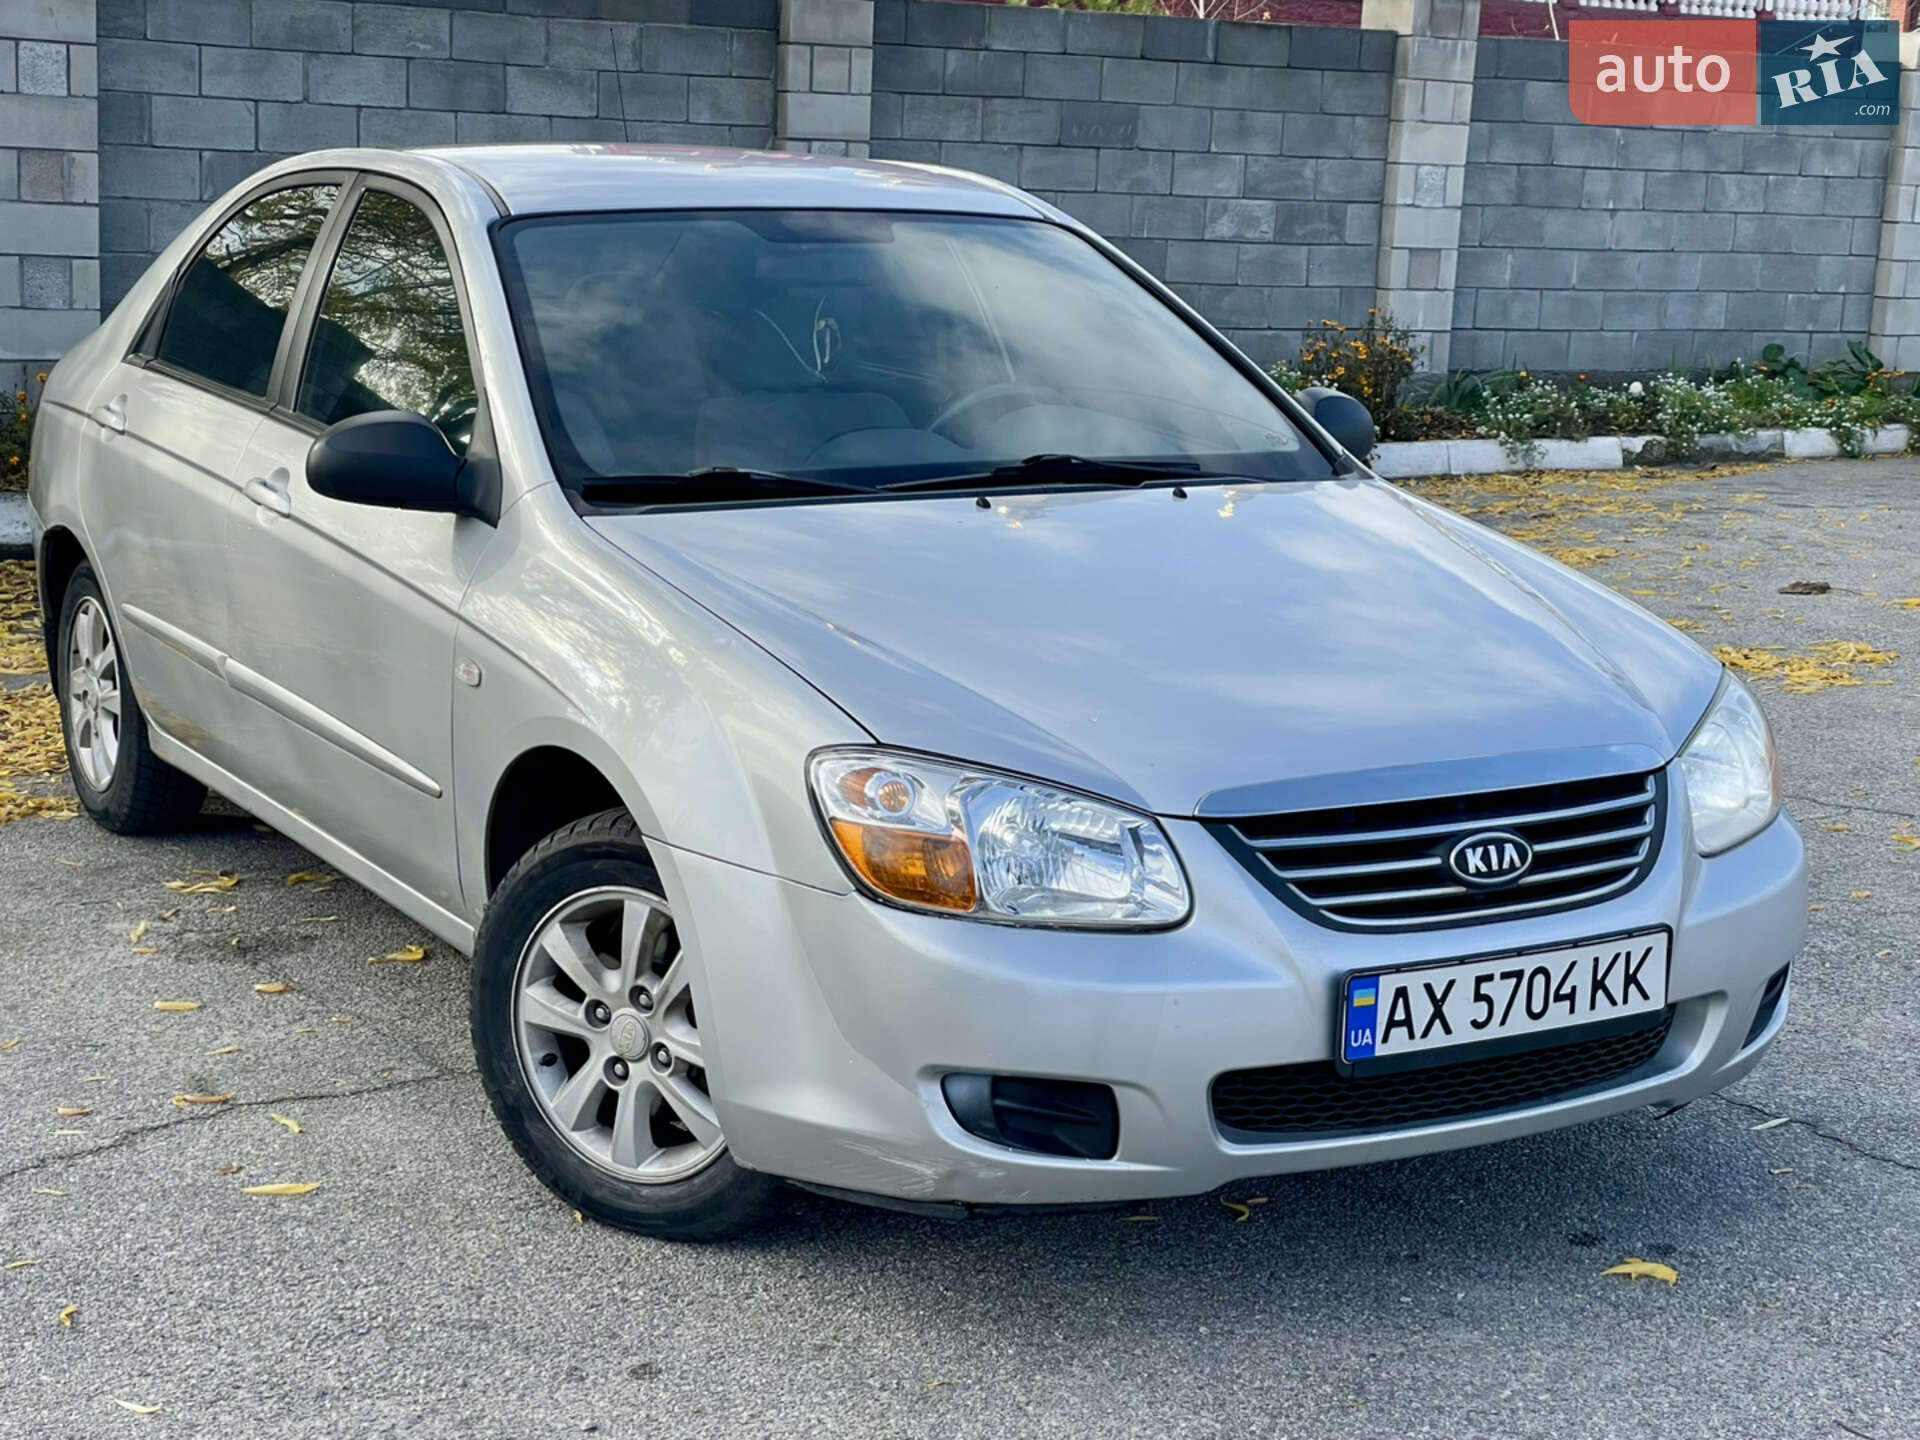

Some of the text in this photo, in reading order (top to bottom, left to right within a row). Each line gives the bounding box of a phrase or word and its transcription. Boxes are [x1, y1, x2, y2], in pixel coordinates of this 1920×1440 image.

[1464, 843, 1522, 874] KIA
[1381, 946, 1654, 1044] AX 5704 KK
[1351, 1027, 1373, 1048] UA
